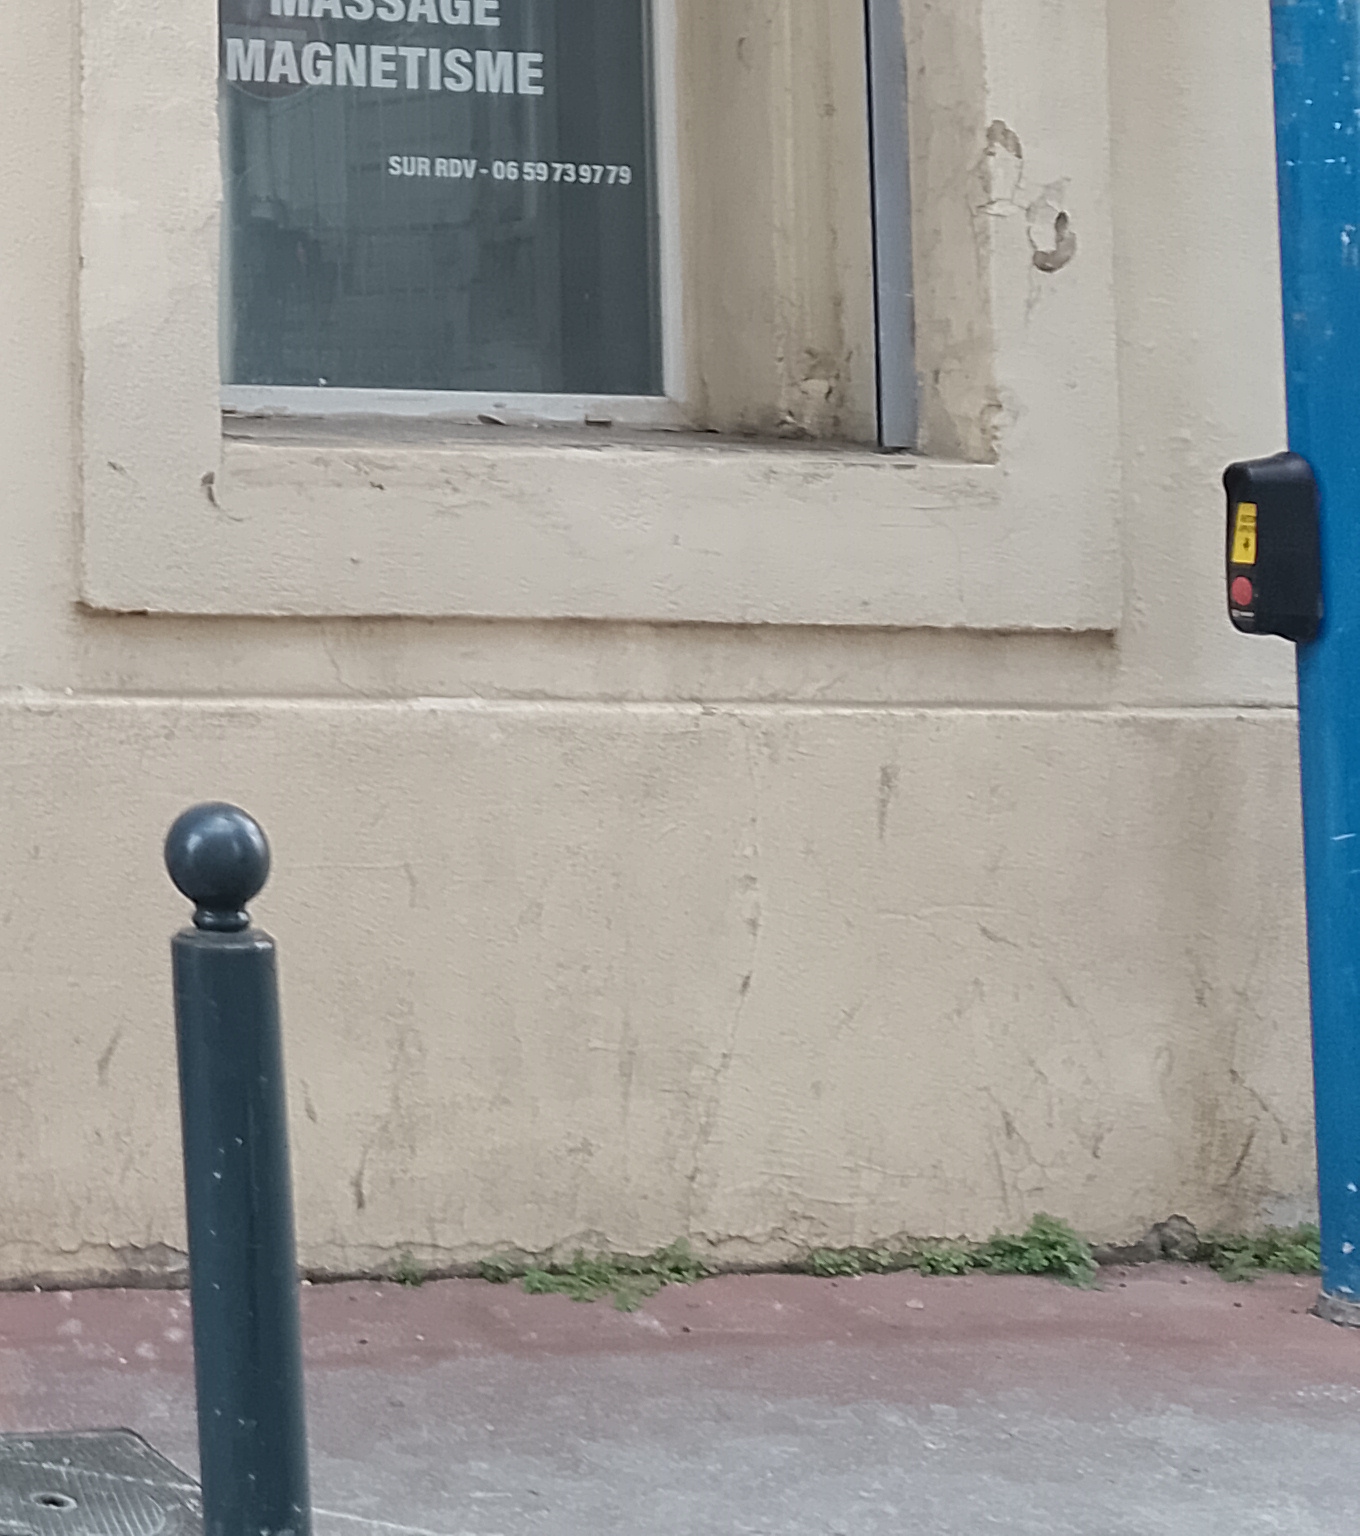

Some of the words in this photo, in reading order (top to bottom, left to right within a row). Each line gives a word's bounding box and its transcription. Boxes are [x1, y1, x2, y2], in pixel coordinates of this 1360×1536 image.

[225, 37, 544, 96] MAGNETISME
[387, 156, 430, 177] SUR
[434, 157, 478, 179] RDV
